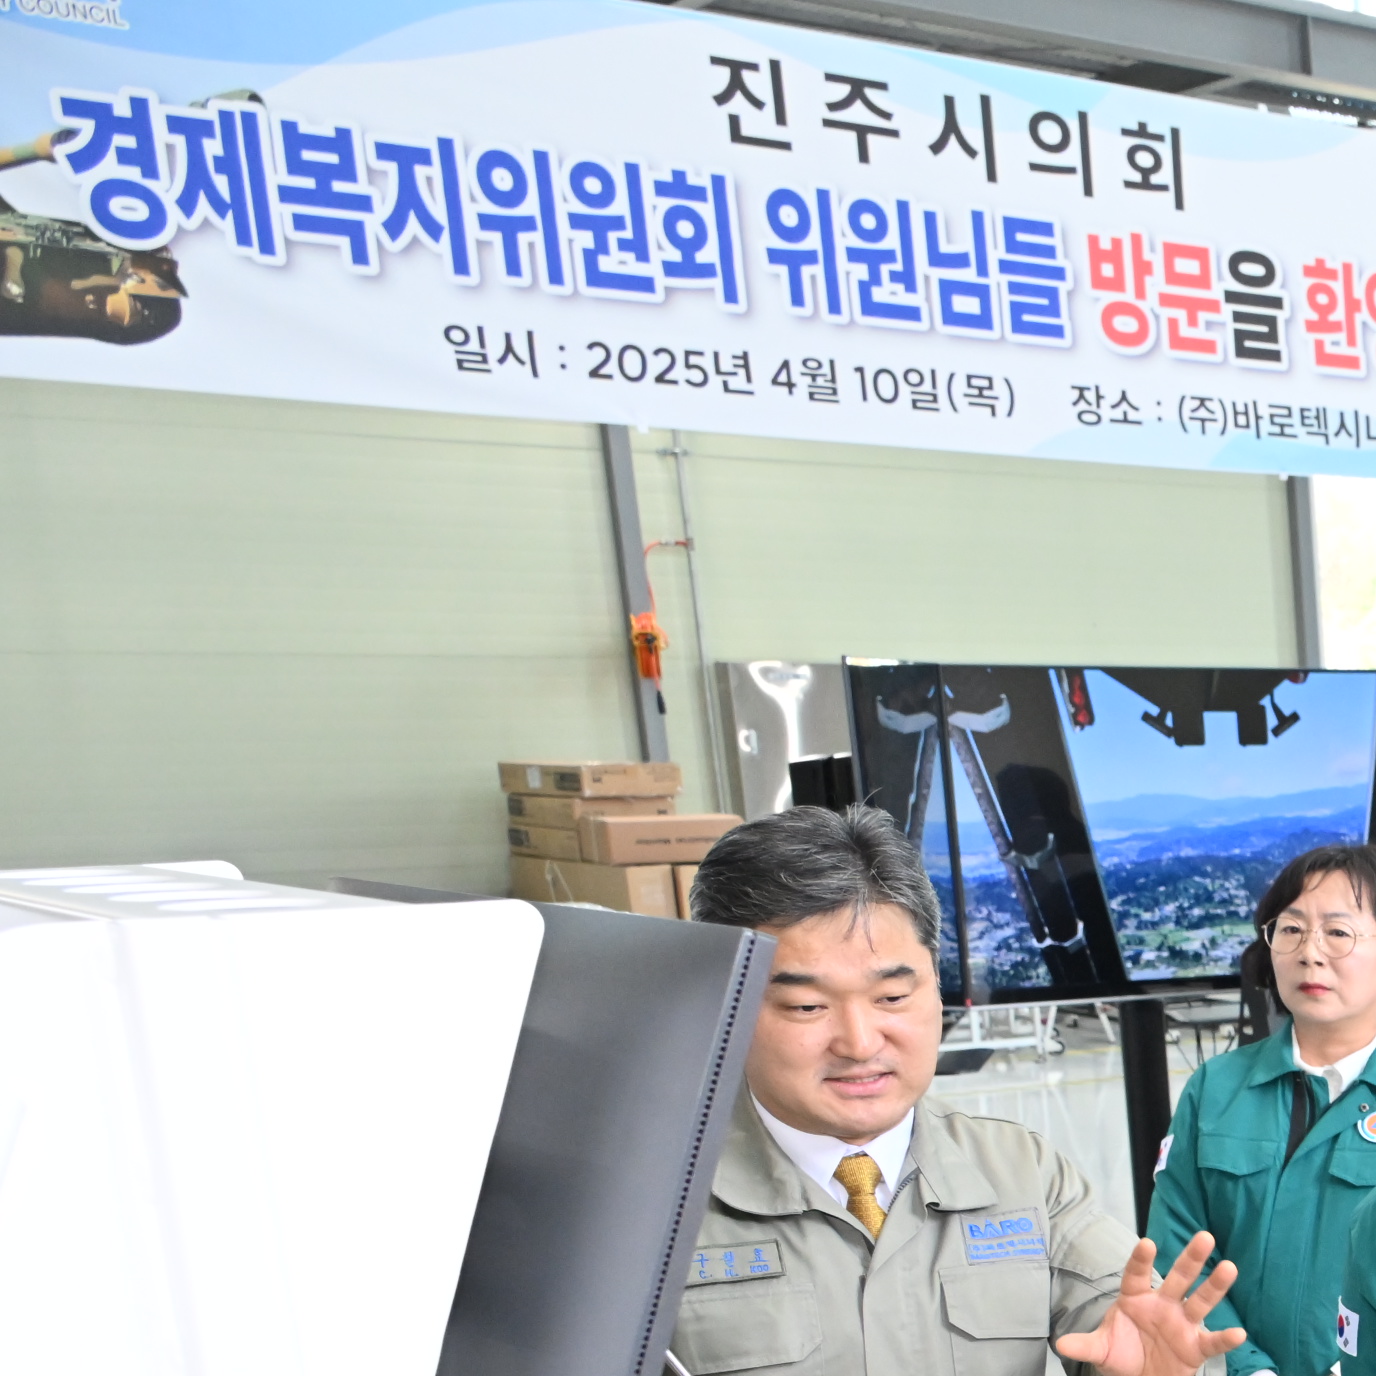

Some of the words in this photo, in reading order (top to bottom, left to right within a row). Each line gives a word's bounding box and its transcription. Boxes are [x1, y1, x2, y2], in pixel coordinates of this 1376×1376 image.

[19, 0, 126, 28] COUNCIL
[58, 95, 740, 306] 경제복지위원회
[765, 186, 1068, 343] 위원님들
[1087, 230, 1285, 364] 방문을
[443, 324, 539, 377] 일시
[586, 340, 754, 395] 2025년
[772, 358, 840, 403] 4월
[854, 366, 1016, 419] 10일(목)
[1070, 383, 1146, 427] 장소
[967, 1217, 1034, 1240] BARO
